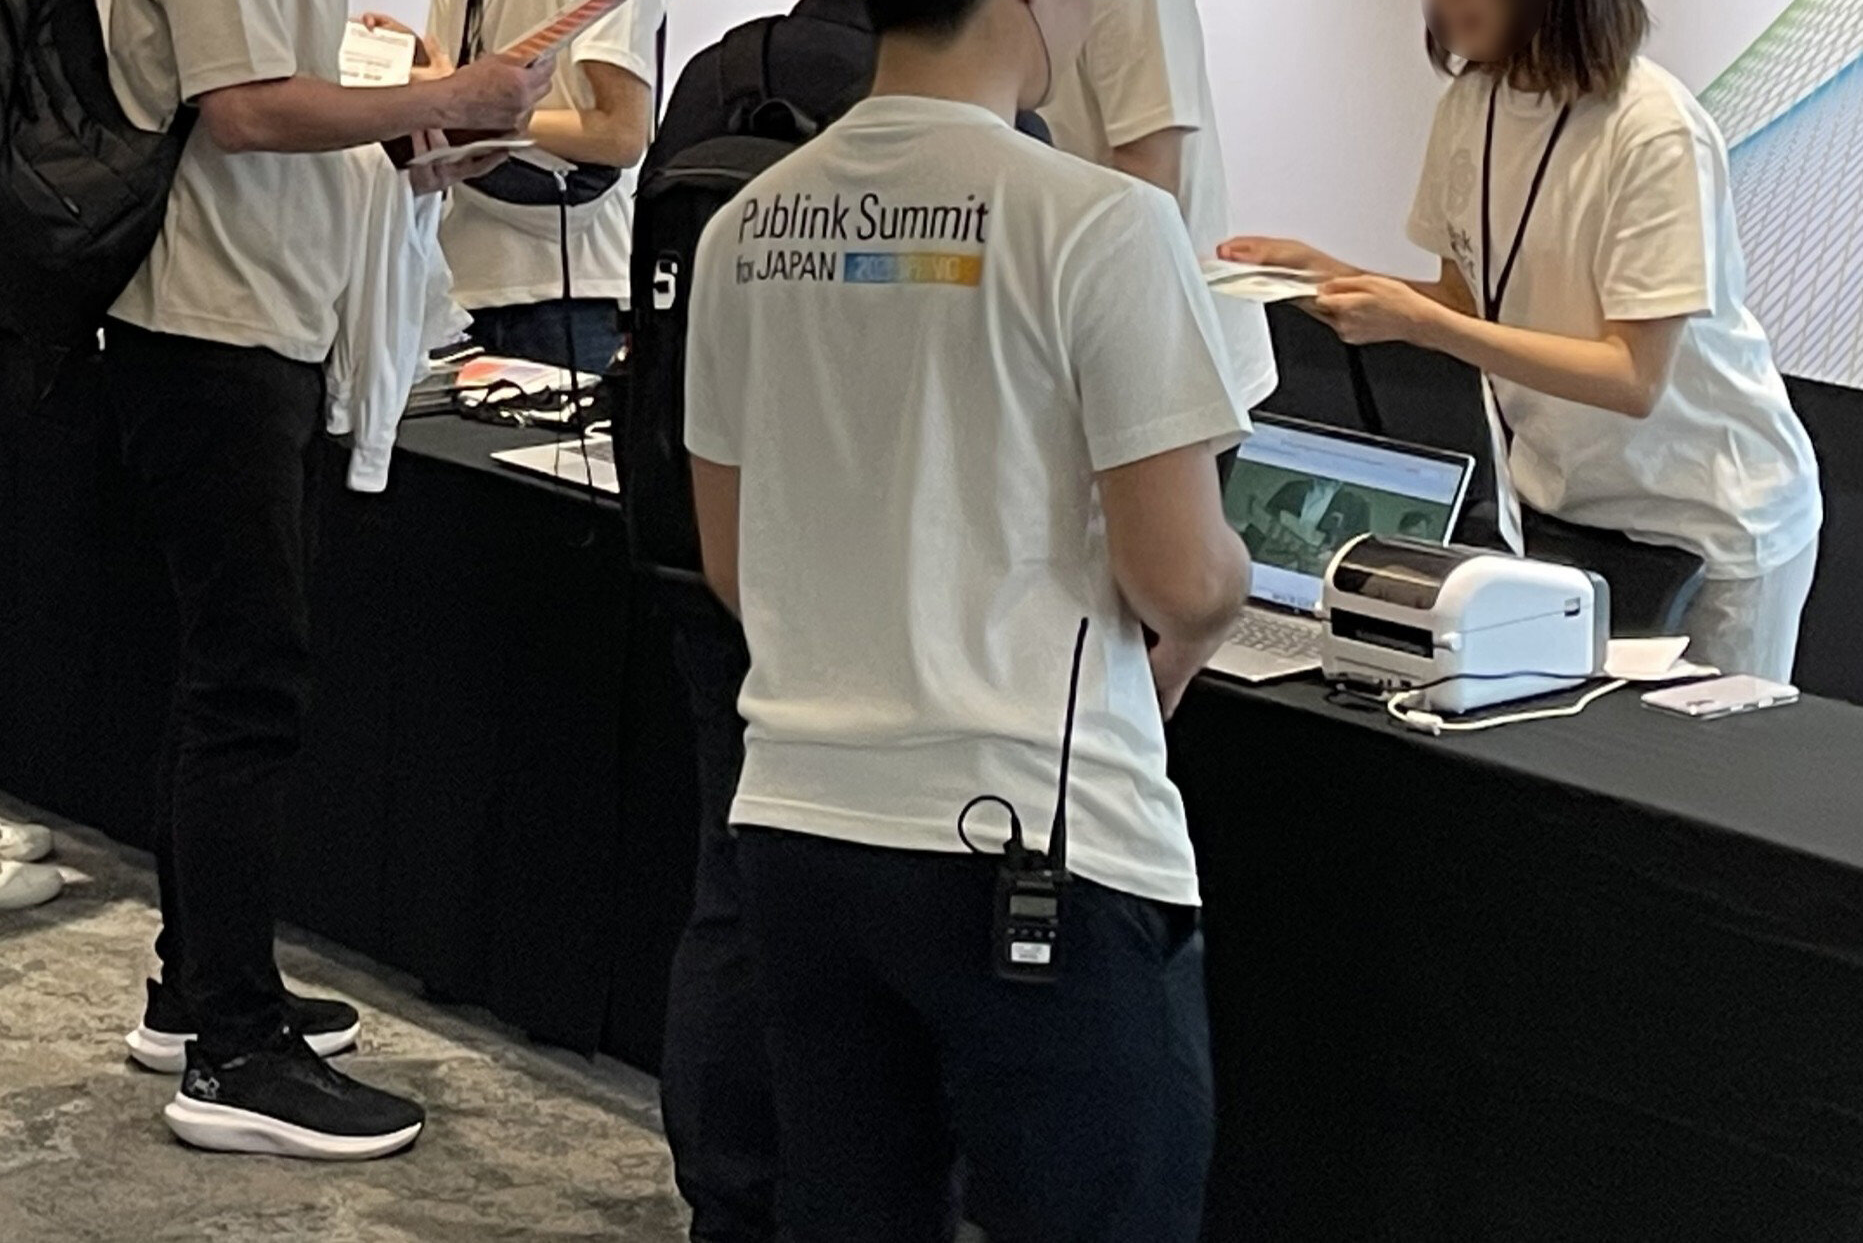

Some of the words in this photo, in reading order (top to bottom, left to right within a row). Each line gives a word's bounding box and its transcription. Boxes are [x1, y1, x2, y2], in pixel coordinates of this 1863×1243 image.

[738, 193, 850, 244] Publink
[856, 193, 989, 243] Summit
[756, 250, 837, 281] JAPAN
